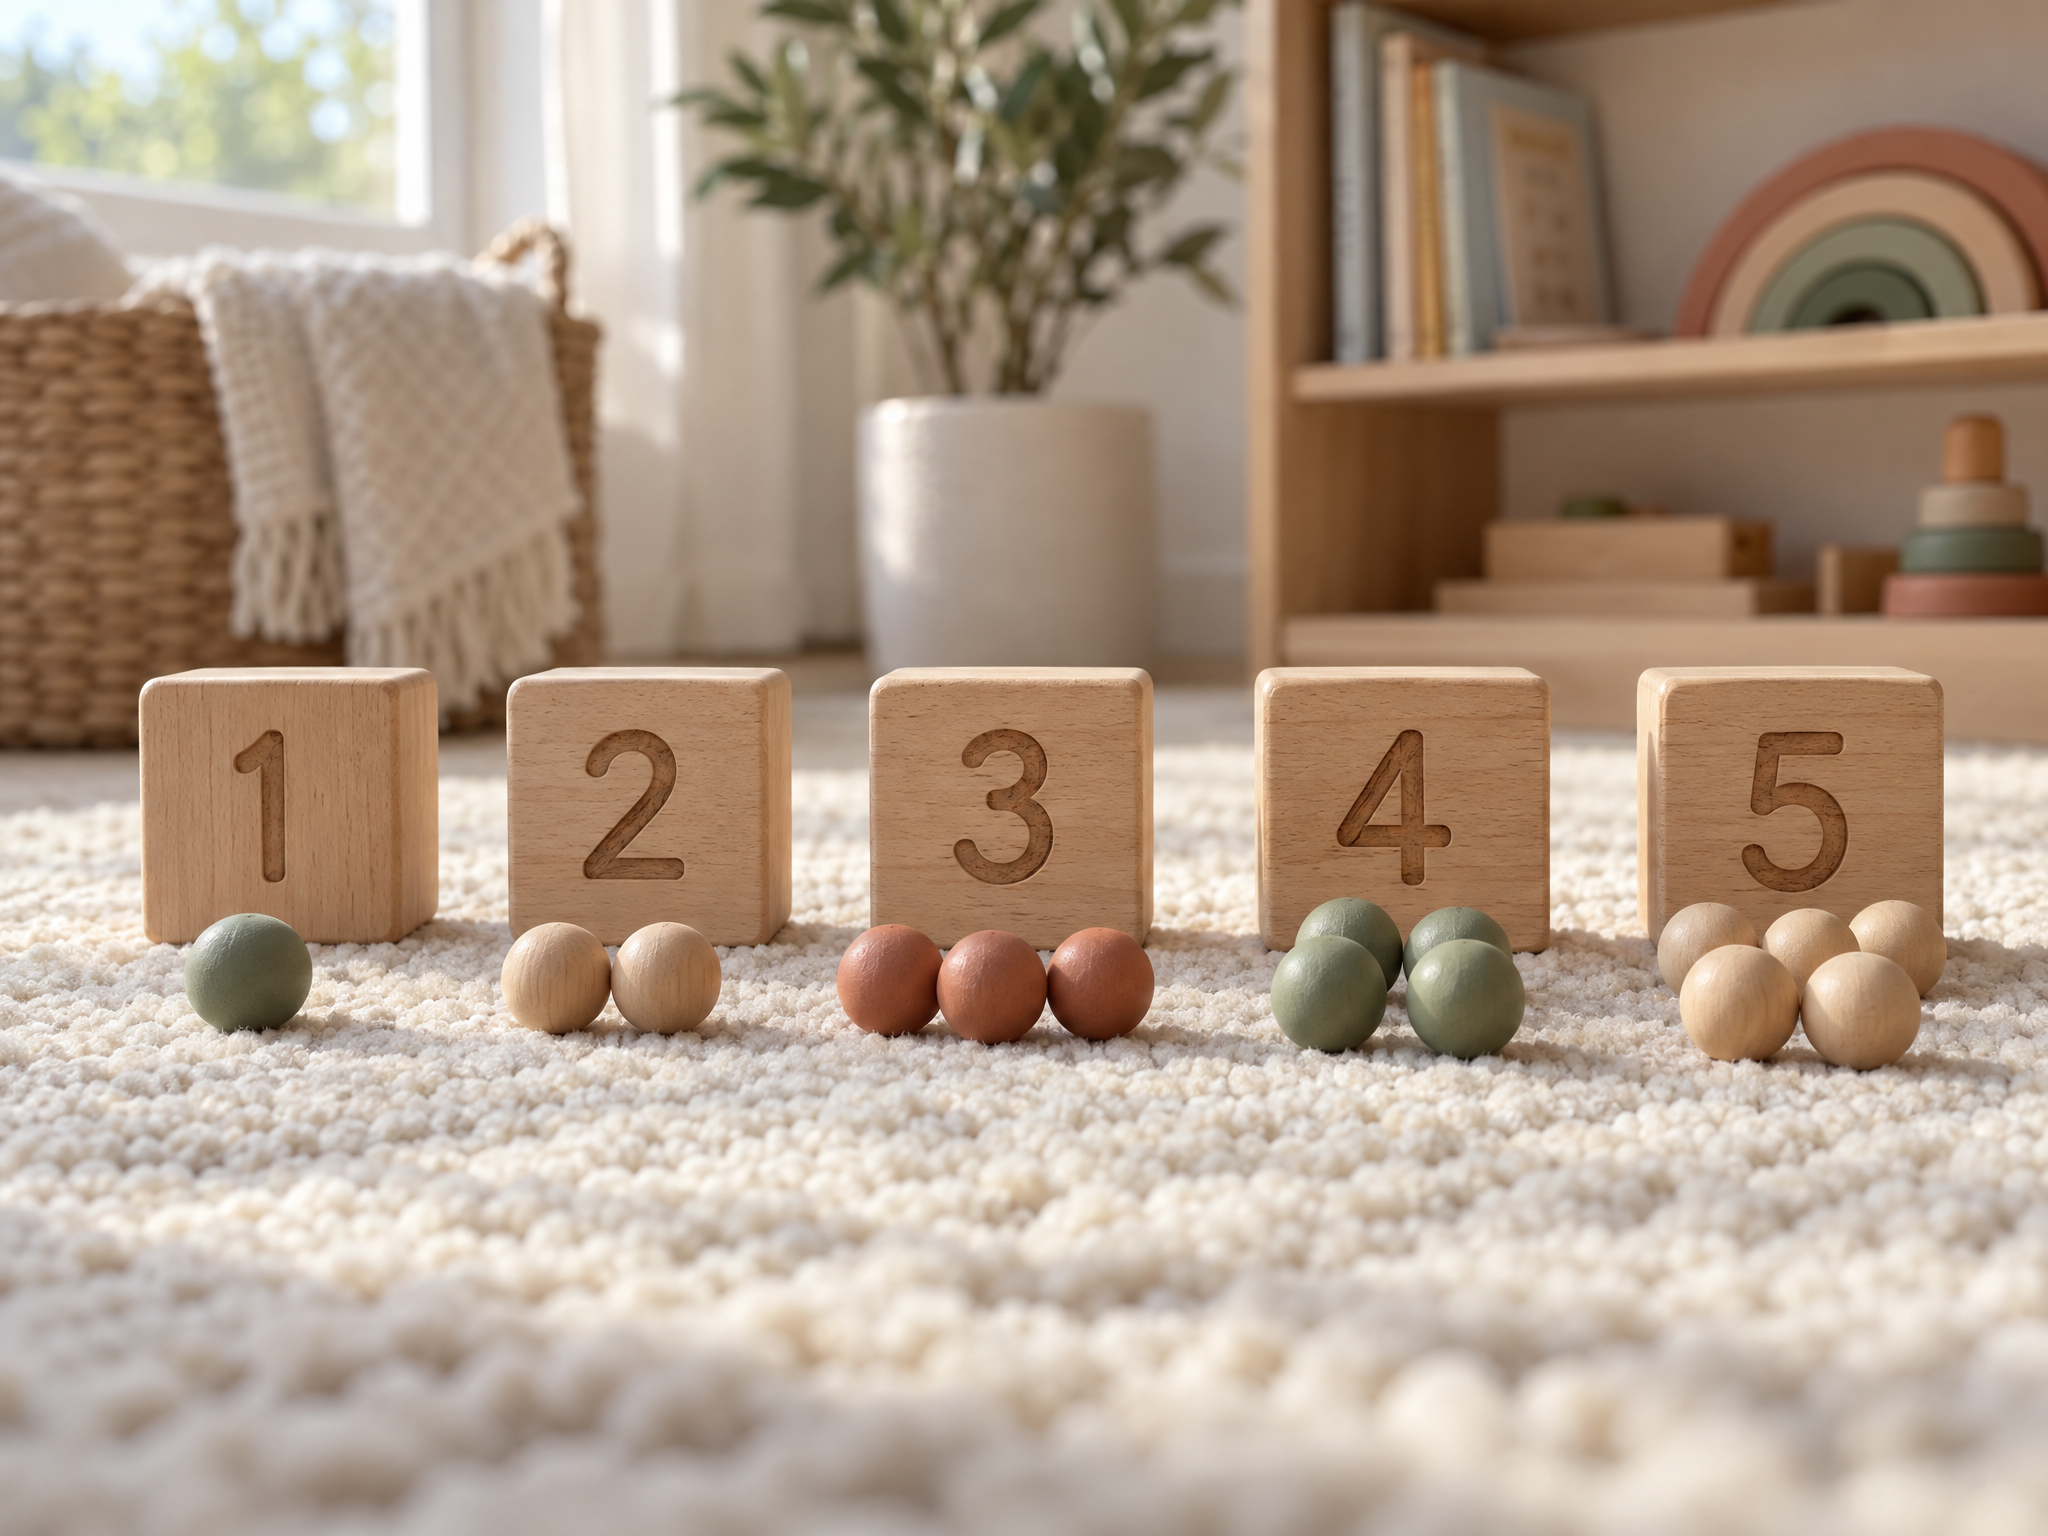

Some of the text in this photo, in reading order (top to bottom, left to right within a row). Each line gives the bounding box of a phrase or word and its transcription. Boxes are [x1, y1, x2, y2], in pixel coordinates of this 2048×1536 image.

[233, 729, 286, 883] 1
[583, 729, 684, 880] 2
[953, 729, 1054, 885] 3
[1336, 729, 1451, 886] 4
[1742, 731, 1848, 892] 5
